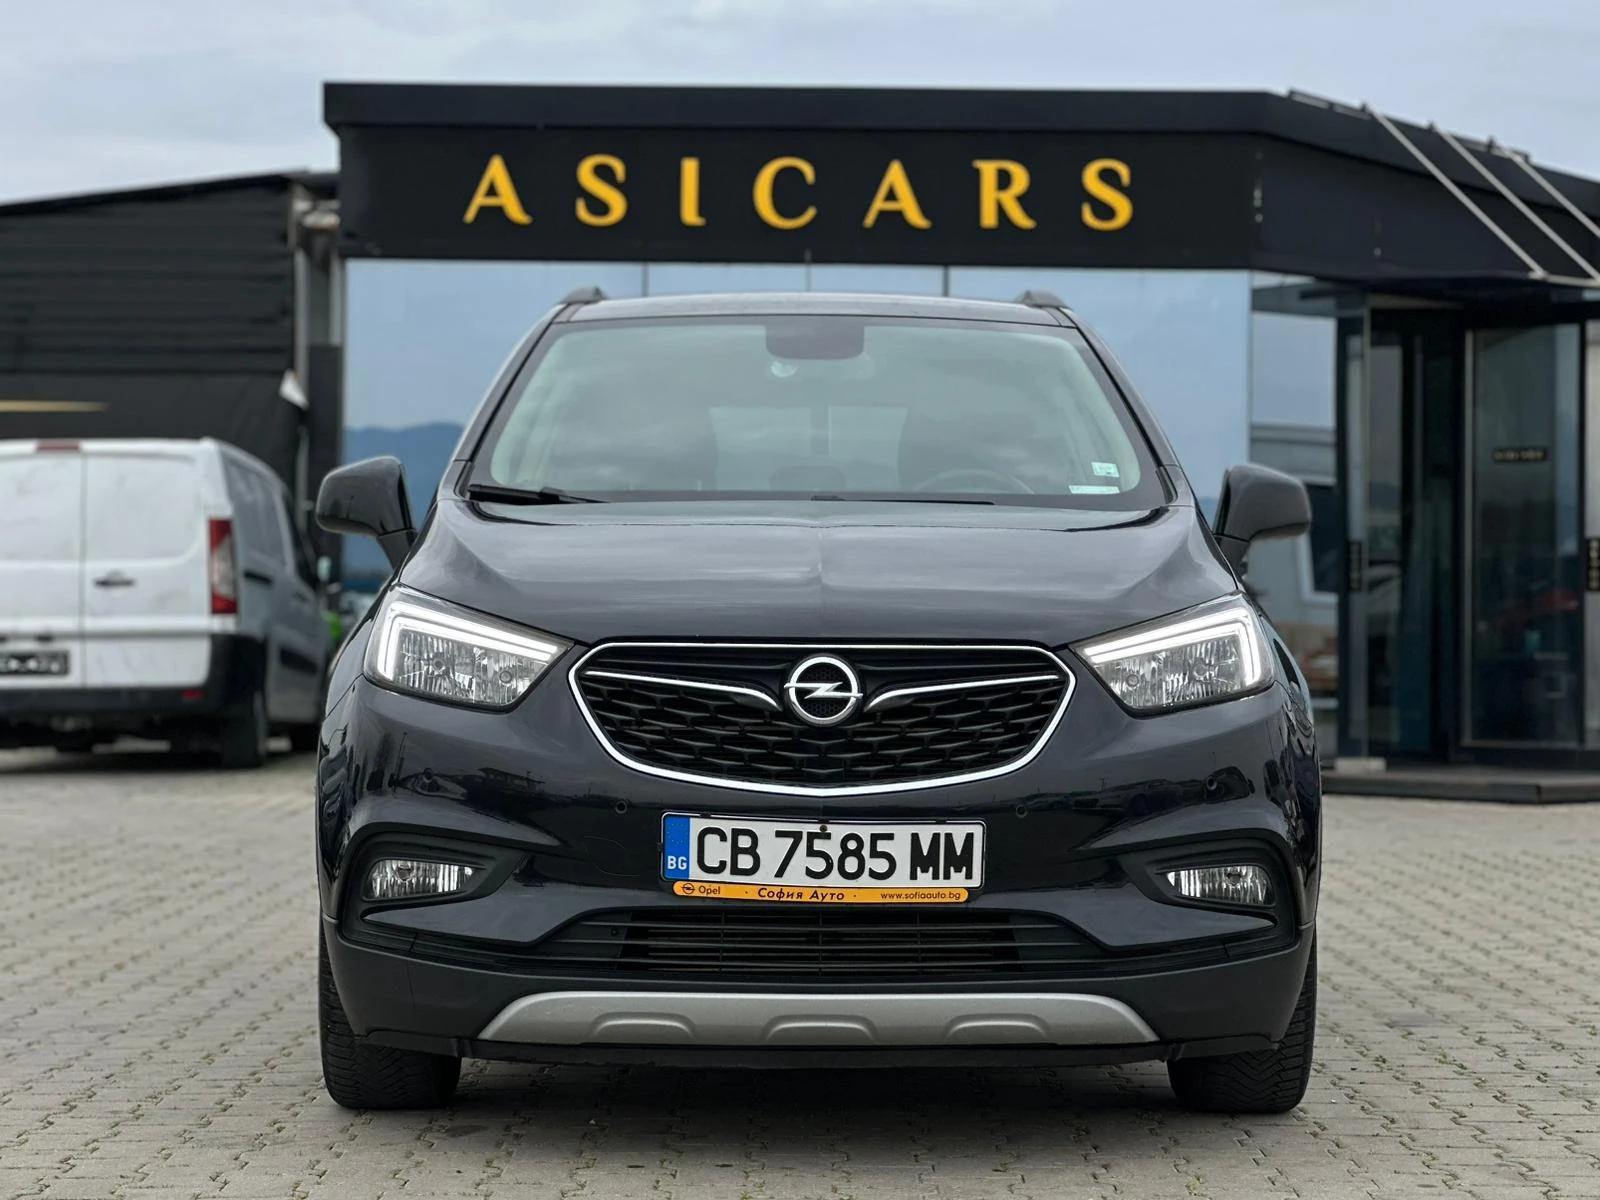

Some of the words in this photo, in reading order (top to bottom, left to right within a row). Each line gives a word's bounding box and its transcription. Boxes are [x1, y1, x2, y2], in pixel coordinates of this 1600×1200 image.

[464, 154, 1133, 230] ASICARS
[697, 826, 761, 876] CB
[774, 830, 897, 881] 7585
[909, 832, 974, 881] MM
[667, 855, 687, 870] BG
[698, 885, 721, 896] Opel
[757, 887, 803, 900] София
[809, 889, 845, 902] Ауто
[880, 890, 961, 901] www.sofiaauto.bg
